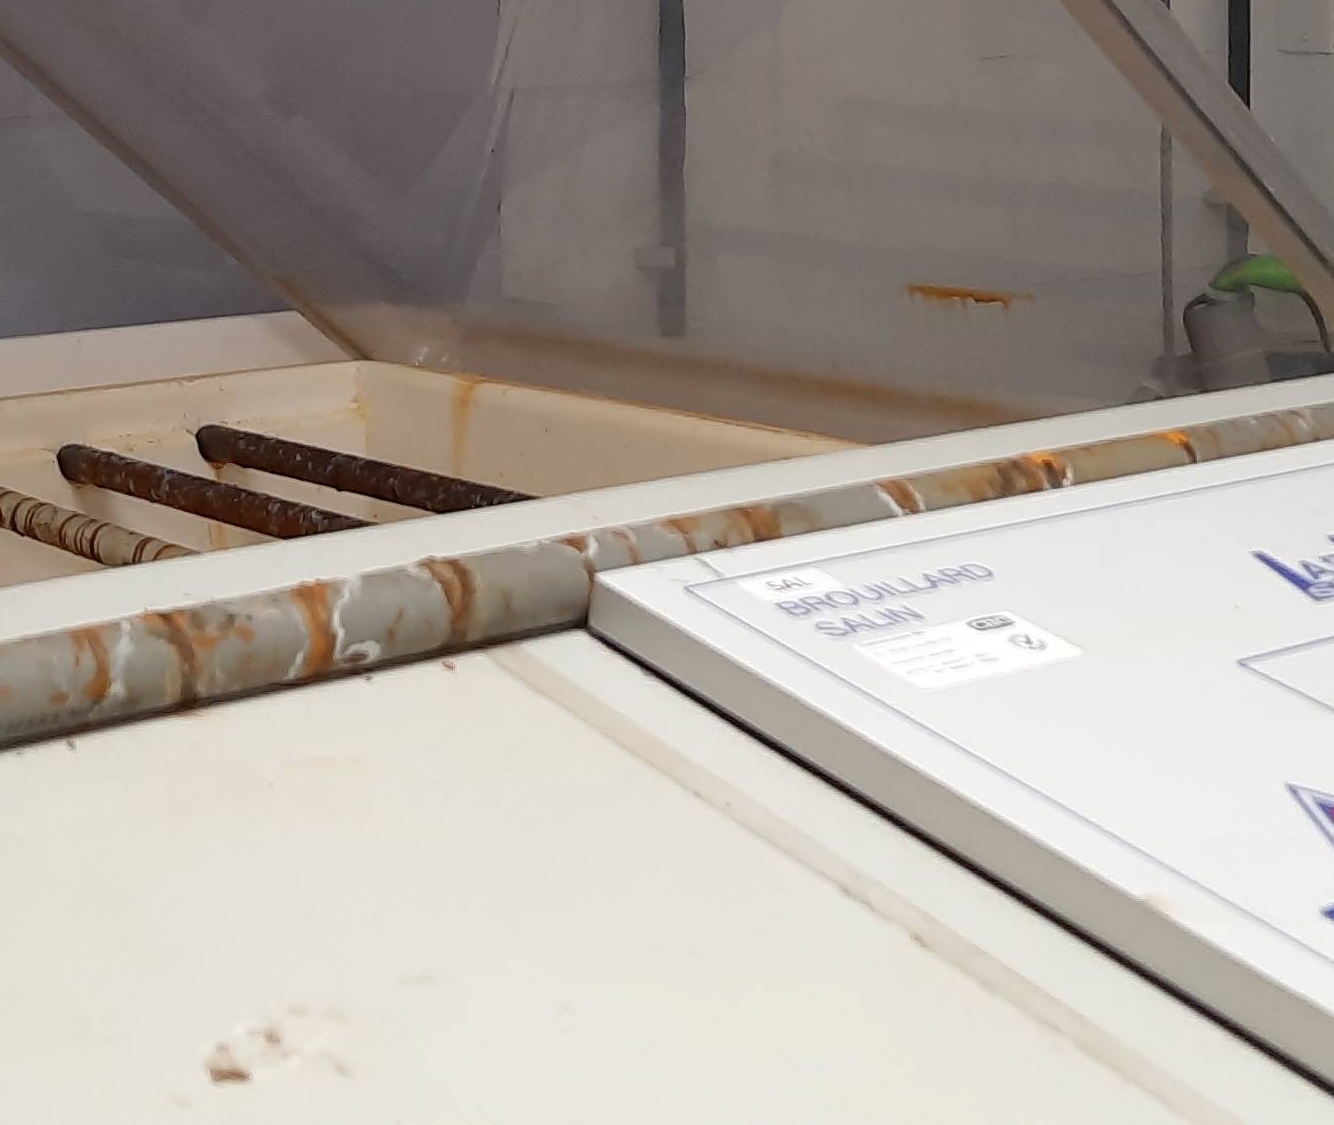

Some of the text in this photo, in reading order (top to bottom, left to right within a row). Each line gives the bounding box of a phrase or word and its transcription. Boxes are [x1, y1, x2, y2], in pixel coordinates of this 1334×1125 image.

[766, 576, 813, 592] SAL
[775, 562, 995, 616] BROUILLARD
[815, 605, 925, 637] SALIN
